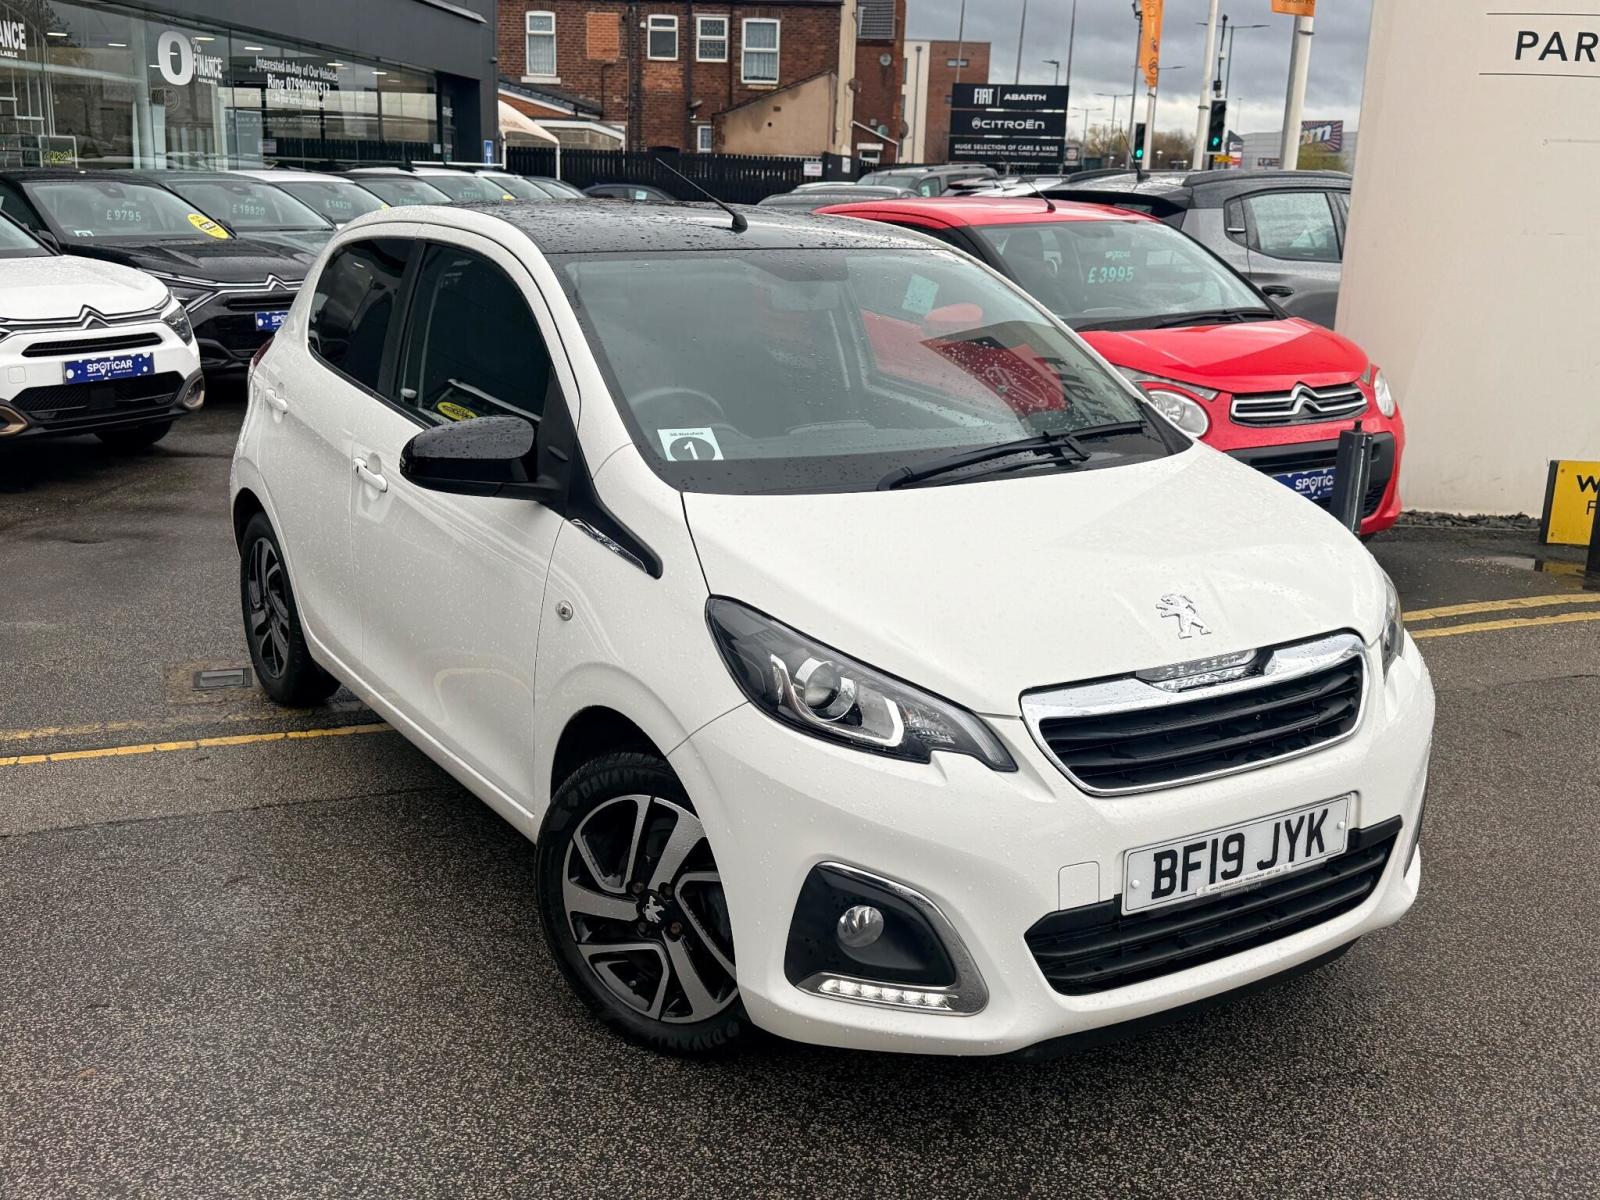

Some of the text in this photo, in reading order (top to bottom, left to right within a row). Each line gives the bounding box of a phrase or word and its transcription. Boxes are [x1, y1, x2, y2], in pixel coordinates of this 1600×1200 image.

[157, 30, 194, 86] 0
[1514, 30, 1599, 63] PAR
[193, 53, 223, 79] FINANCE
[255, 55, 338, 81] Interested in Any of Our Vehicles
[267, 73, 285, 95] Ring
[973, 88, 995, 105] FIAT
[1003, 93, 1047, 101] ABARTH
[973, 143, 1006, 151] SELECTION
[683, 441, 699, 460] 1
[1166, 654, 1240, 678] PEUGEOT
[1151, 832, 1245, 900] BF19
[1256, 808, 1329, 871] JYK
